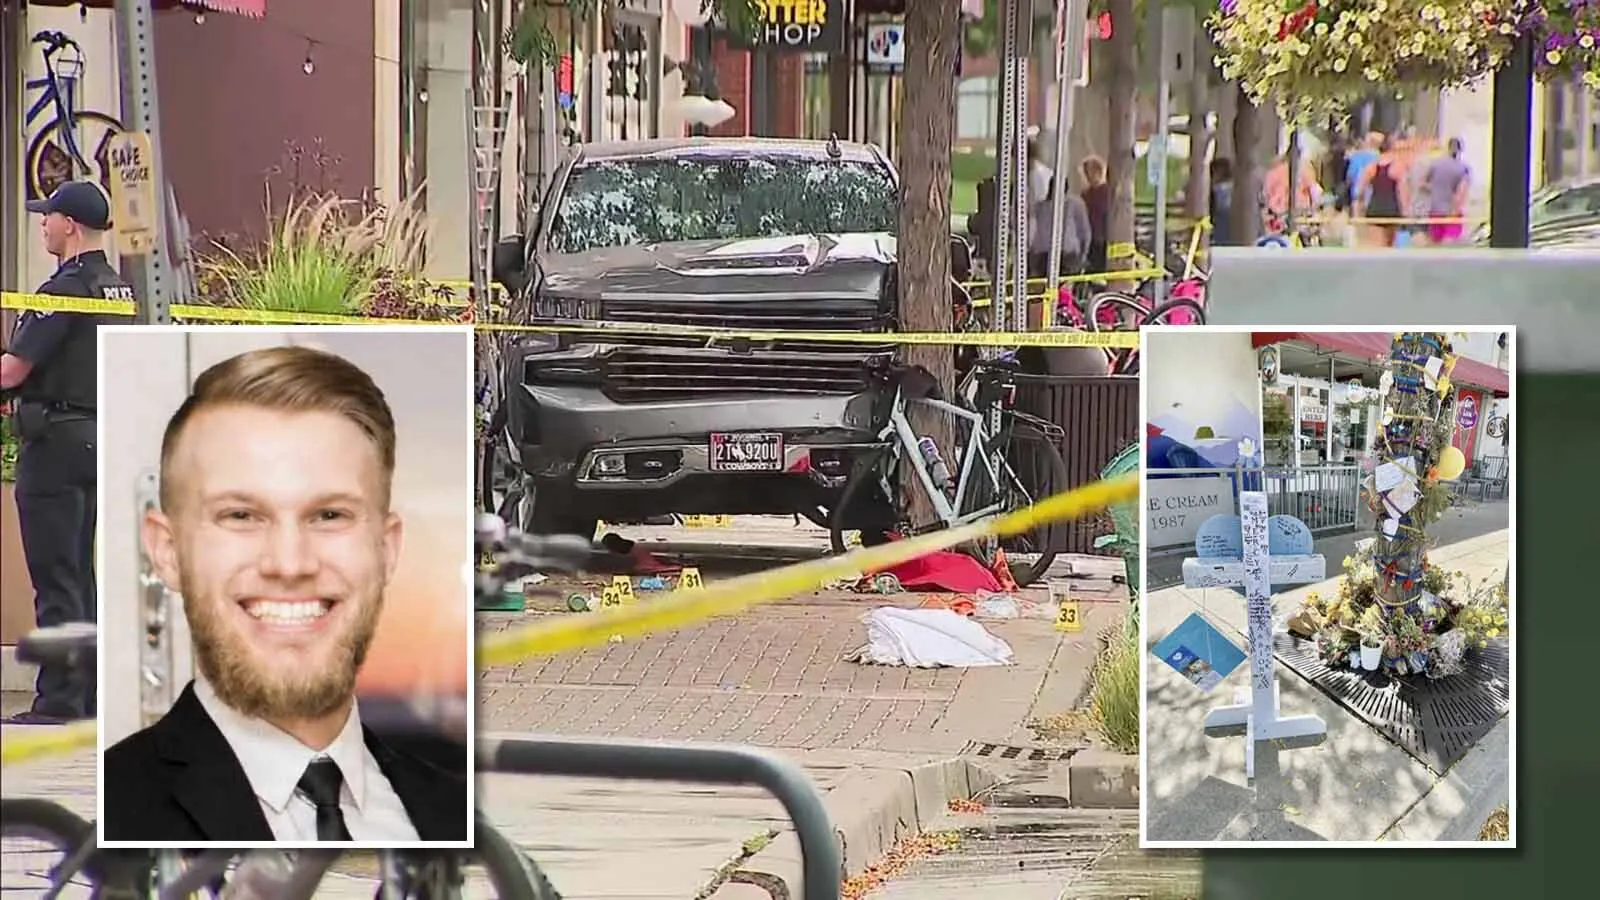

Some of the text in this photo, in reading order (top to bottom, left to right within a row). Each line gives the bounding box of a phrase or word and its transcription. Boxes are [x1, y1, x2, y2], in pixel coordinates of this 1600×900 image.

[753, 23, 821, 45] HOP
[111, 147, 140, 169] SAFE
[120, 167, 150, 183] CHOICE
[1147, 494, 1219, 511] E CREAM
[1151, 514, 1186, 530] 1987
[685, 574, 700, 588] 31
[604, 592, 620, 607] 34
[1059, 608, 1076, 624] 33
